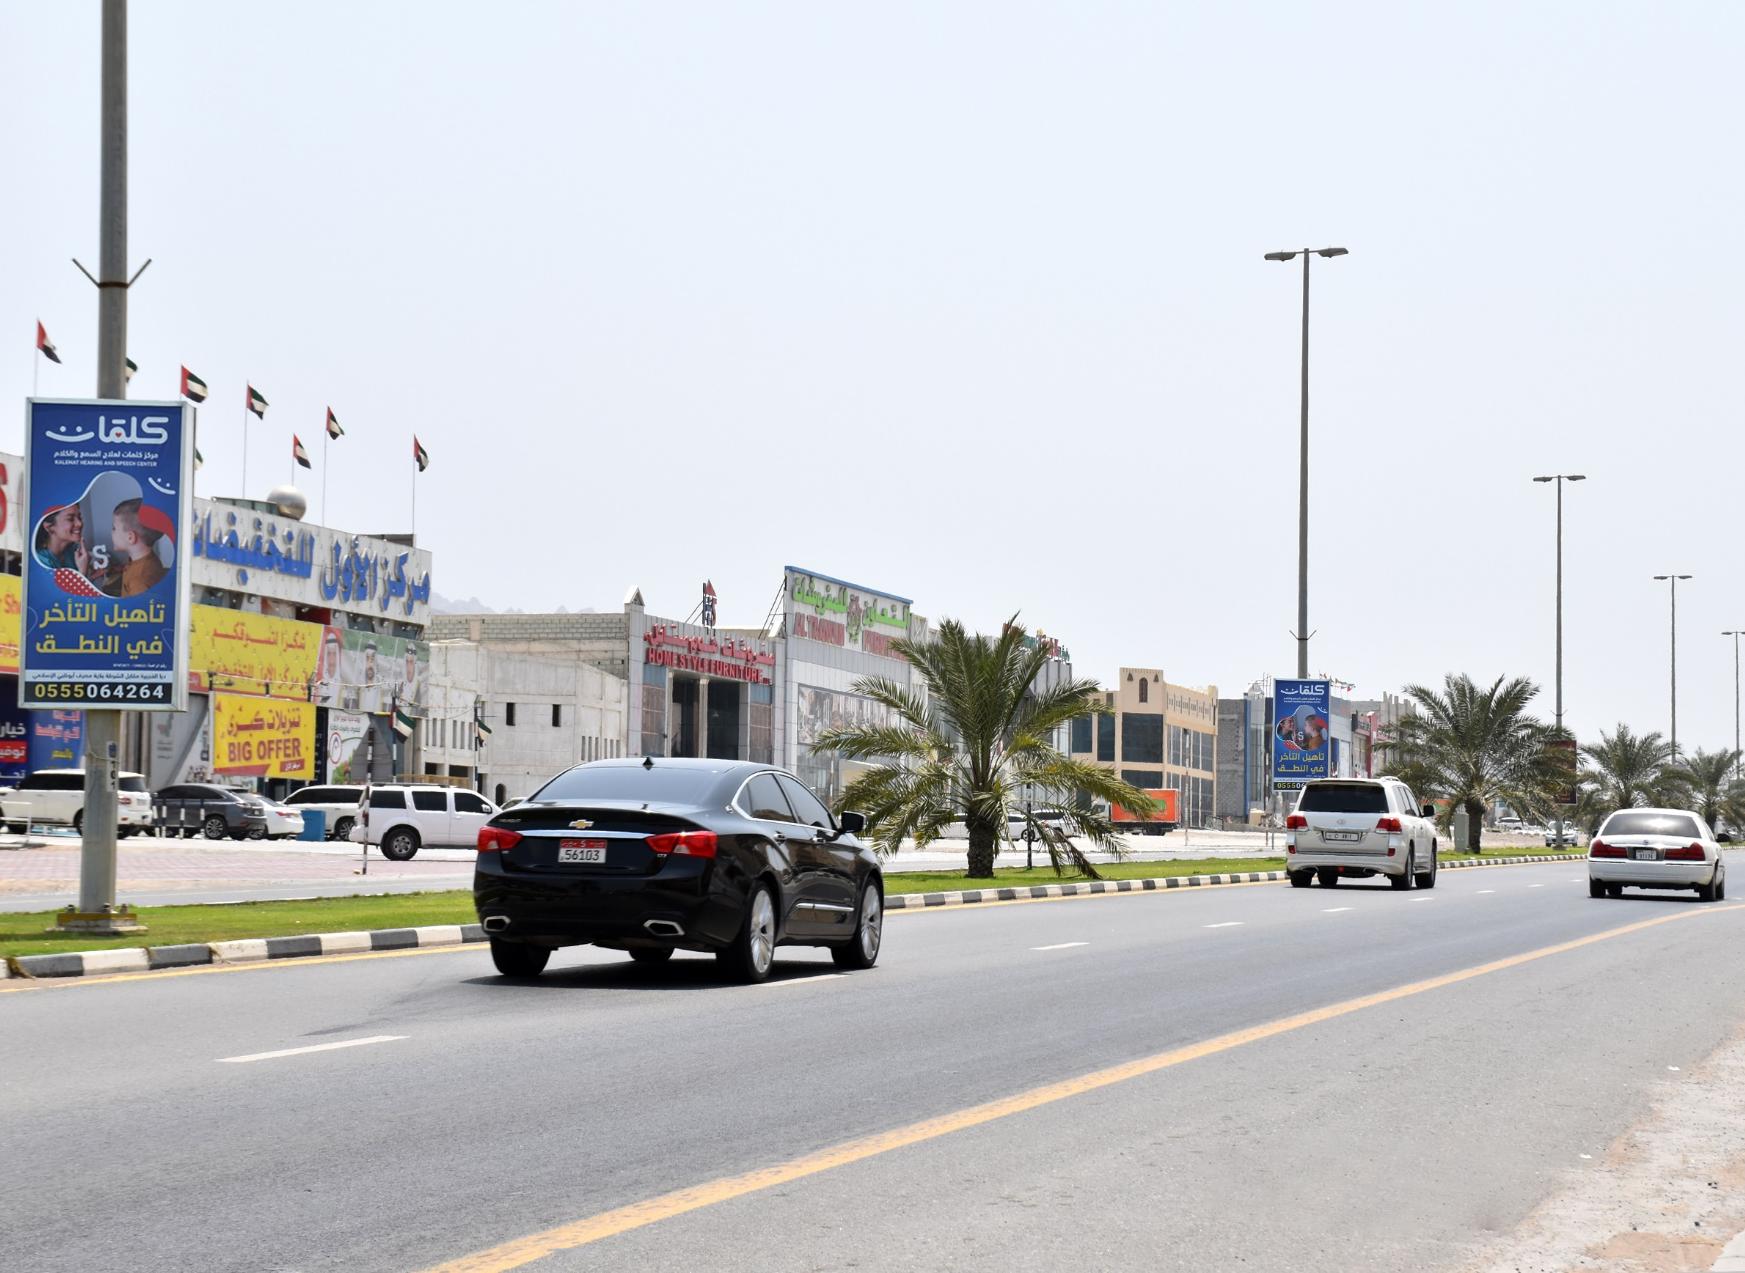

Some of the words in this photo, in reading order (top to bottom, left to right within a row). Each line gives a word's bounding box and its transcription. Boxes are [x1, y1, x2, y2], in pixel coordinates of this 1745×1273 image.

[79, 450, 102, 459] السمع
[121, 451, 143, 459] كلمات
[143, 451, 159, 460] مركز
[379, 550, 431, 617] مركز
[39, 598, 98, 628] التأخر
[104, 598, 166, 628] تأهيل
[126, 635, 164, 660] في
[647, 648, 679, 669] HOME
[679, 653, 711, 674] STYLE
[711, 658, 764, 684] FURNITURE
[34, 683, 164, 699] 0555064264
[227, 740, 253, 762] BIG
[256, 737, 302, 761] OFFER
[564, 849, 600, 861] 56103
